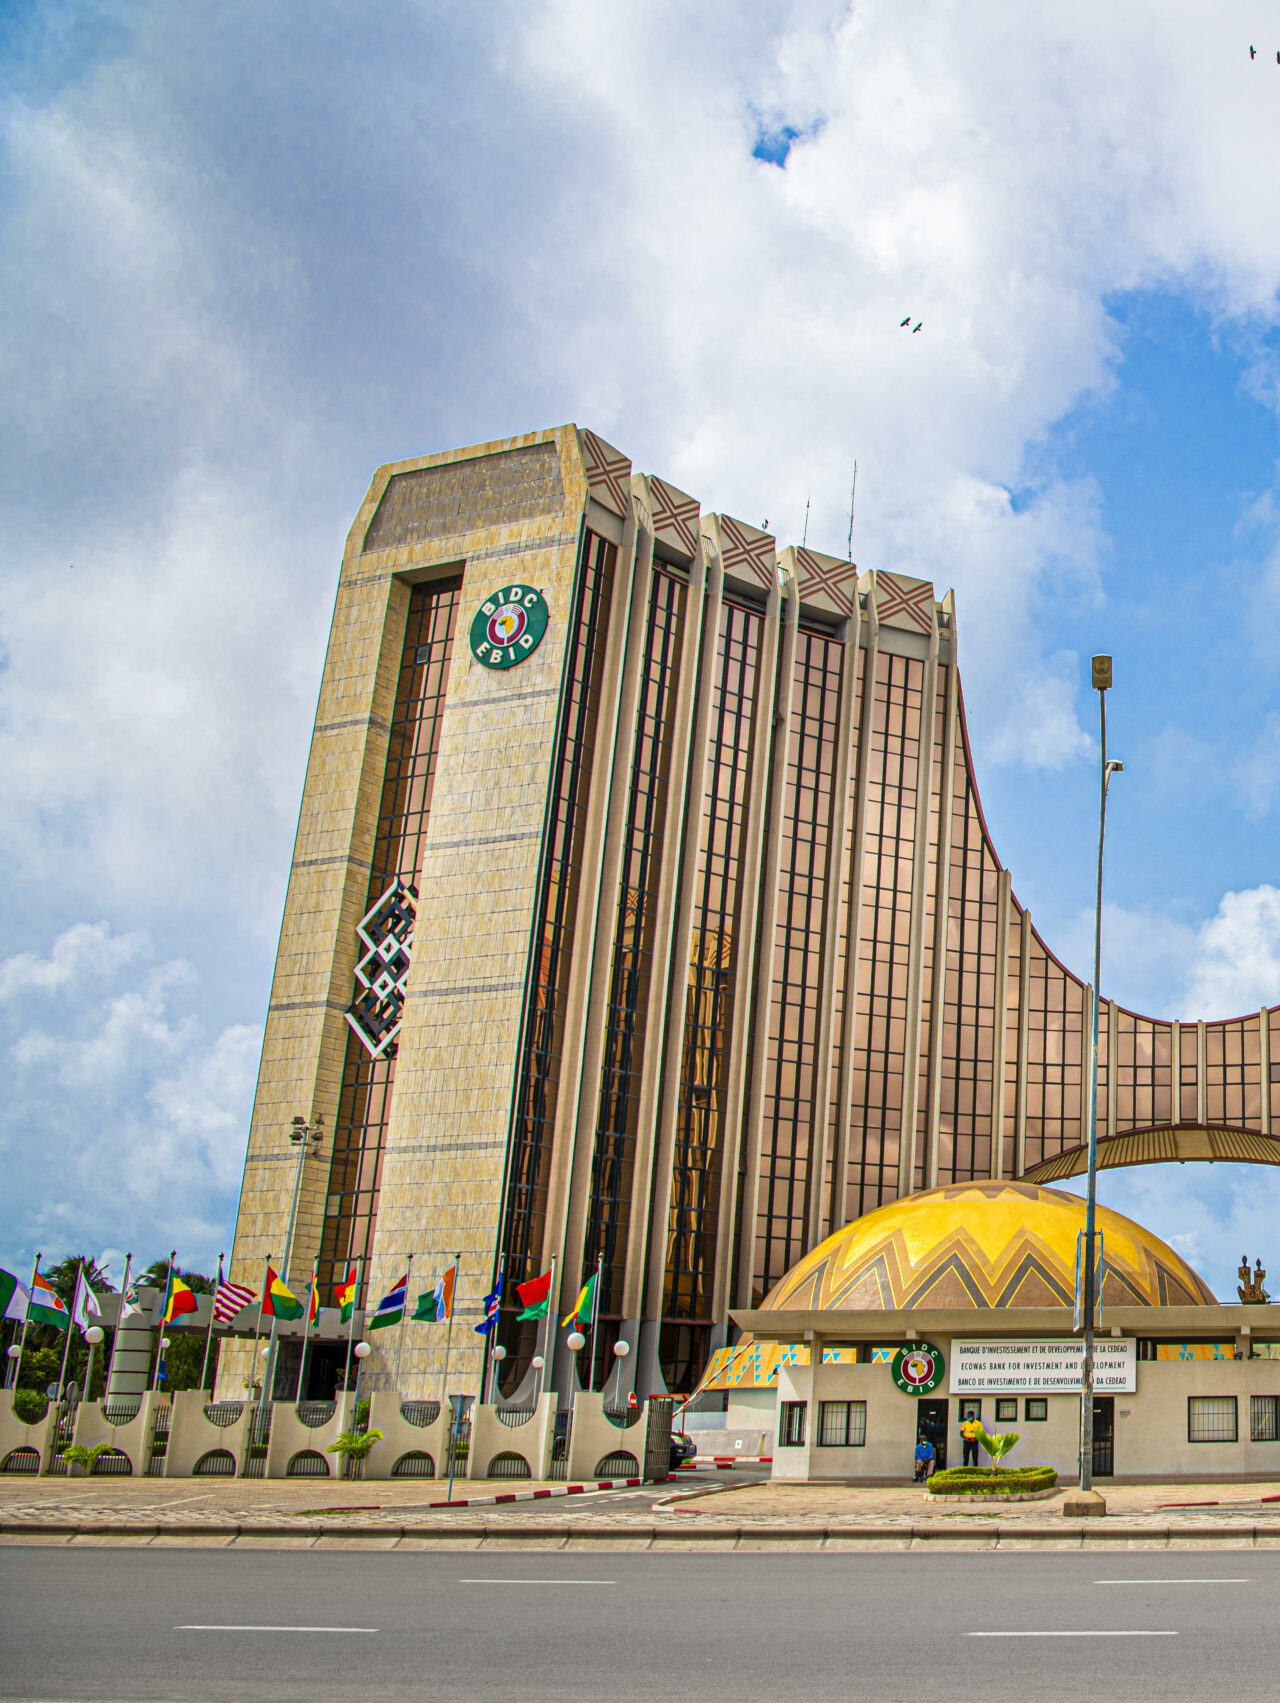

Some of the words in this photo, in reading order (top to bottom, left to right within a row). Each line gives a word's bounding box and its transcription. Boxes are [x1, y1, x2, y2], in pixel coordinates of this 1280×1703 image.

[481, 587, 538, 616] BIDC
[475, 634, 534, 663] EBID
[901, 1343, 938, 1358] BIDC
[959, 1346, 981, 1354] BANQUE
[981, 1346, 1031, 1354] D'INVESTISSEMENT
[961, 1362, 986, 1371] ECOWAS
[989, 1362, 1006, 1370] BANK
[1008, 1362, 1021, 1370] FOR
[1023, 1362, 1063, 1370] INVESTMENT
[1065, 1361, 1078, 1370] AND
[1080, 1361, 1125, 1369] DELOPMENT
[897, 1378, 935, 1393] EBID
[958, 1378, 976, 1386] BANCO
[977, 1378, 985, 1386] DE
[986, 1378, 1026, 1386] INVESTIMENTO
[1105, 1377, 1127, 1385] CEDEAO
